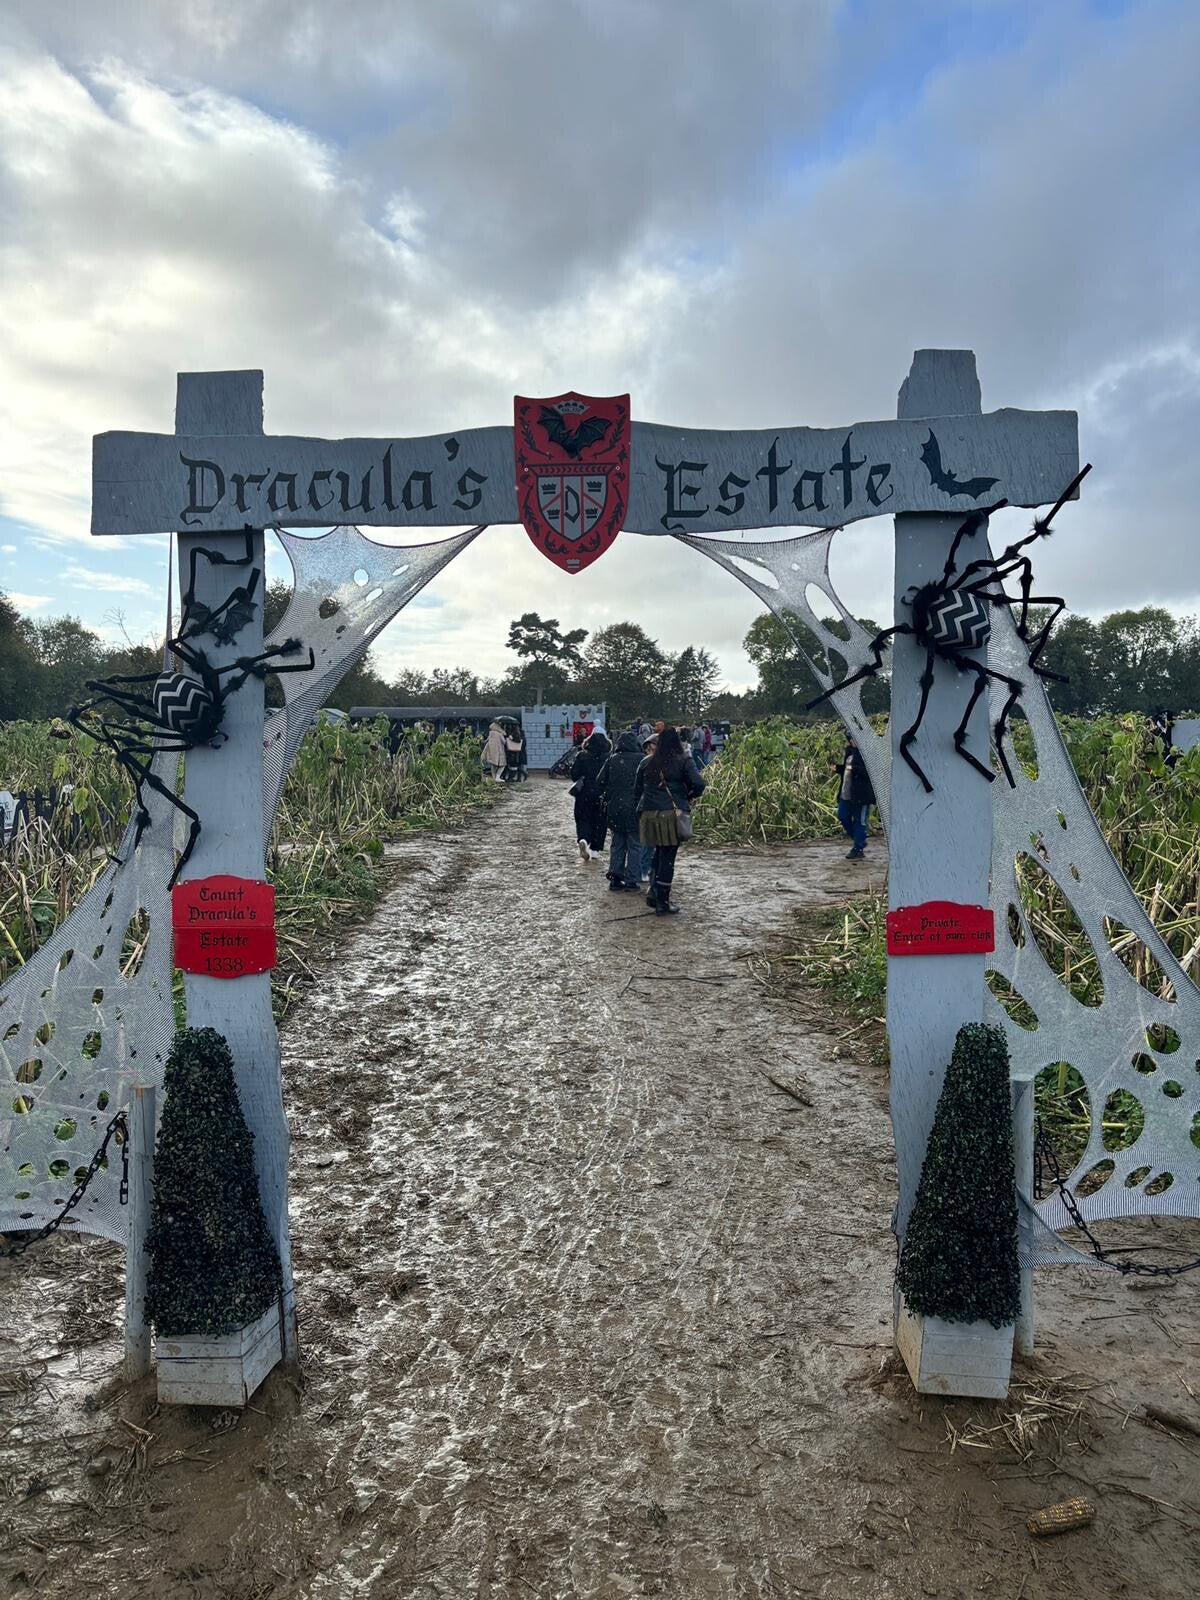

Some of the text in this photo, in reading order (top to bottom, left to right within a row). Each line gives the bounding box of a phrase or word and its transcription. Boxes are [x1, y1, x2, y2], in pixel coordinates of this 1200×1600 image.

[180, 432, 893, 530] Dracula's Estate
[200, 887, 244, 902] Count
[189, 906, 256, 922] Dracula's
[921, 918, 959, 930] Private
[200, 932, 248, 948] Estate
[893, 931, 924, 943] Enter
[206, 957, 243, 971] 1338
